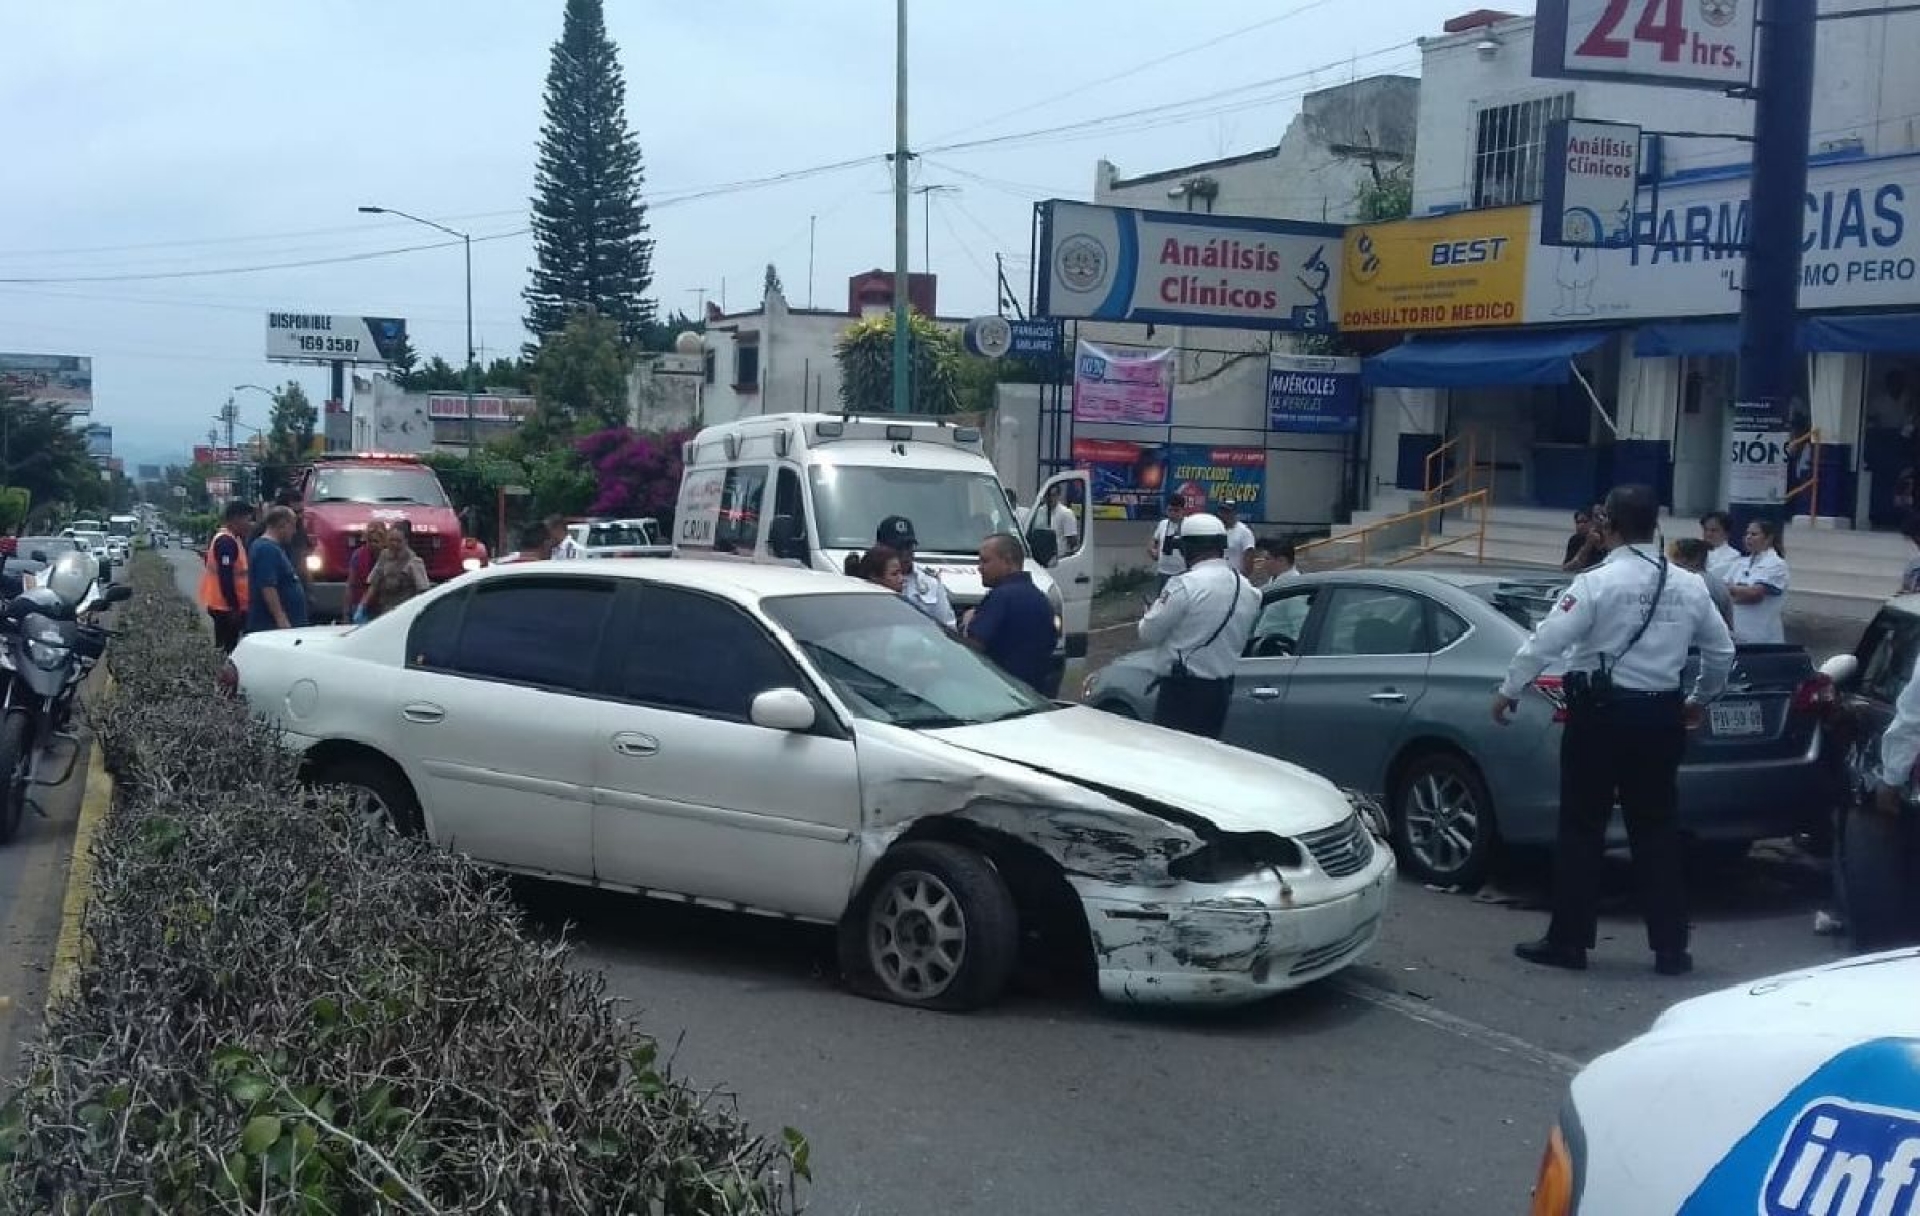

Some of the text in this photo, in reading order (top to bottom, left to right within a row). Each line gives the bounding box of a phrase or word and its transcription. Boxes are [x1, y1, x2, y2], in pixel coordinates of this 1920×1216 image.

[1574, 0, 1742, 69] 24 hrs.
[1567, 136, 1633, 158] Análisis
[1567, 157, 1631, 178] Clínicos
[1630, 184, 1905, 266] FARMCIAS
[1160, 237, 1280, 273] Análisis
[1431, 236, 1508, 266] BEST
[1846, 257, 1915, 283] PERO
[1159, 275, 1278, 310] Clínicos
[269, 312, 332, 331] DISPONIBLE
[1343, 301, 1515, 326] CONSULTORIO MEDICO
[1778, 1116, 1920, 1216] inf
